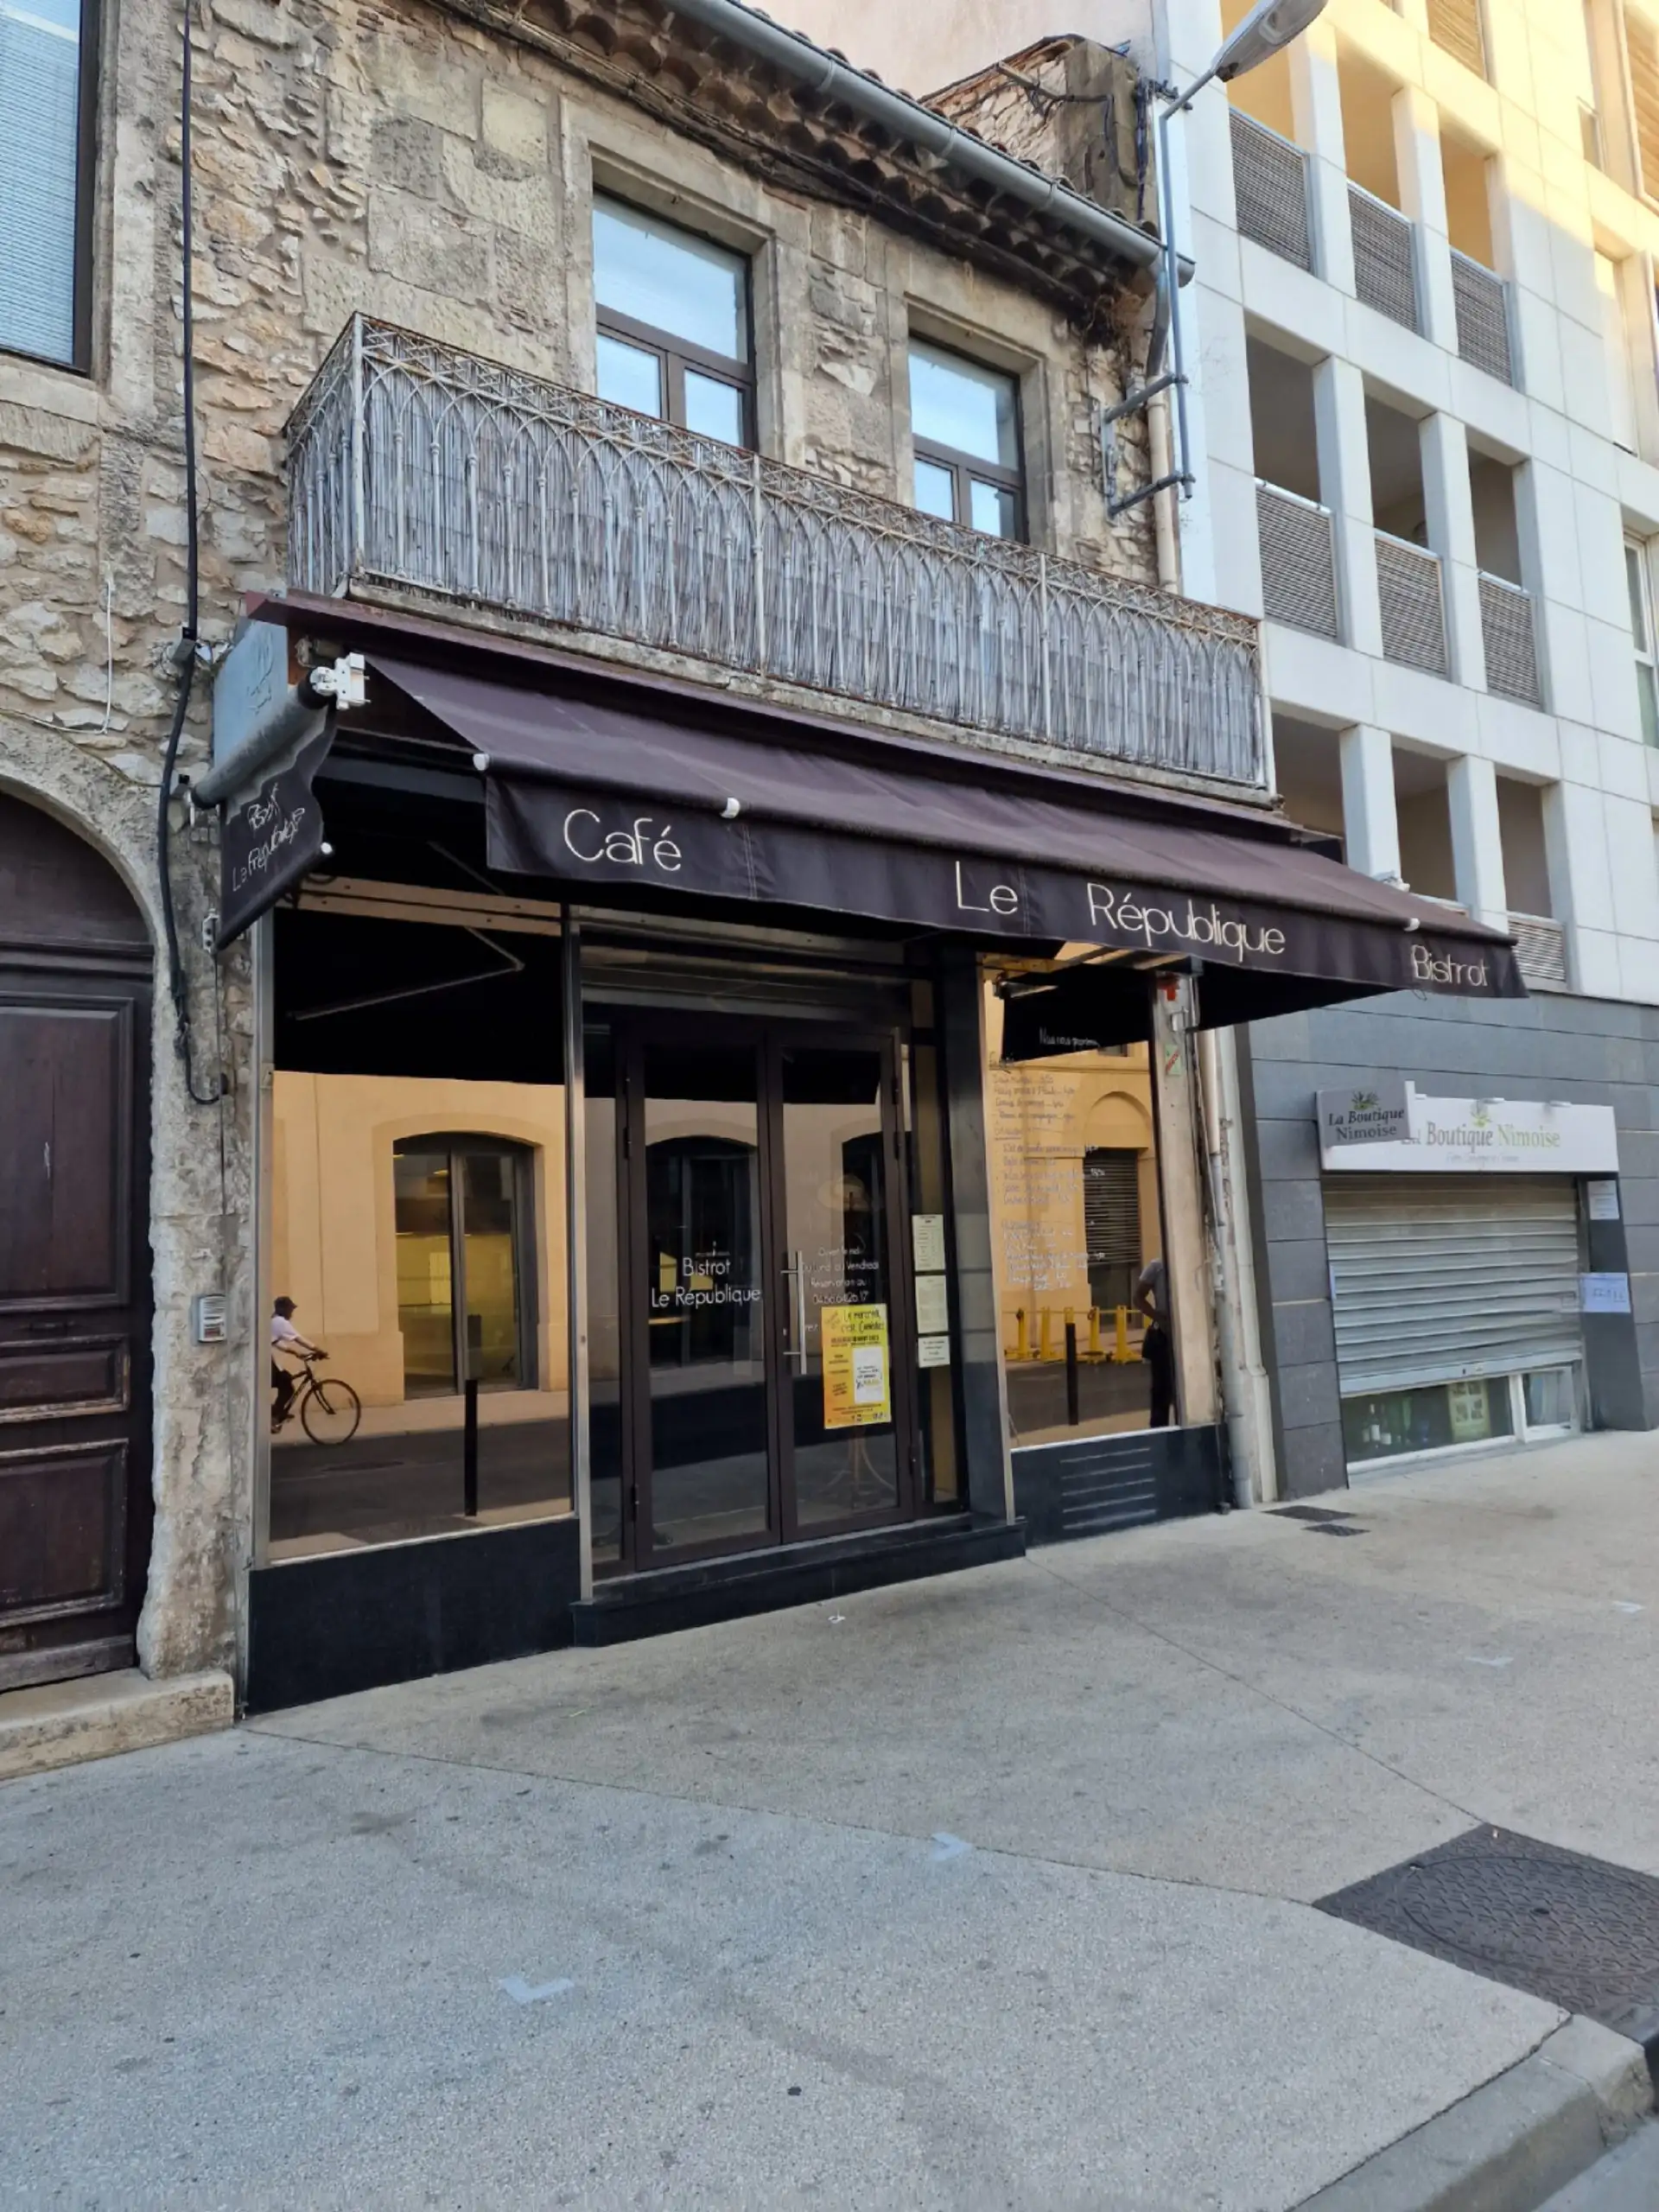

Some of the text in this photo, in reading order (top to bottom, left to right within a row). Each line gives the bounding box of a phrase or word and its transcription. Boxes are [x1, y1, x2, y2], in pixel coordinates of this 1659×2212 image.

[563, 809, 682, 872] Café
[956, 861, 1287, 963] Le République
[1411, 944, 1489, 986] Bistrot
[1328, 1108, 1405, 1126] La Boutique
[1426, 1120, 1493, 1154] Boutique
[682, 1257, 730, 1276] Bistrot
[652, 1287, 670, 1308] Le
